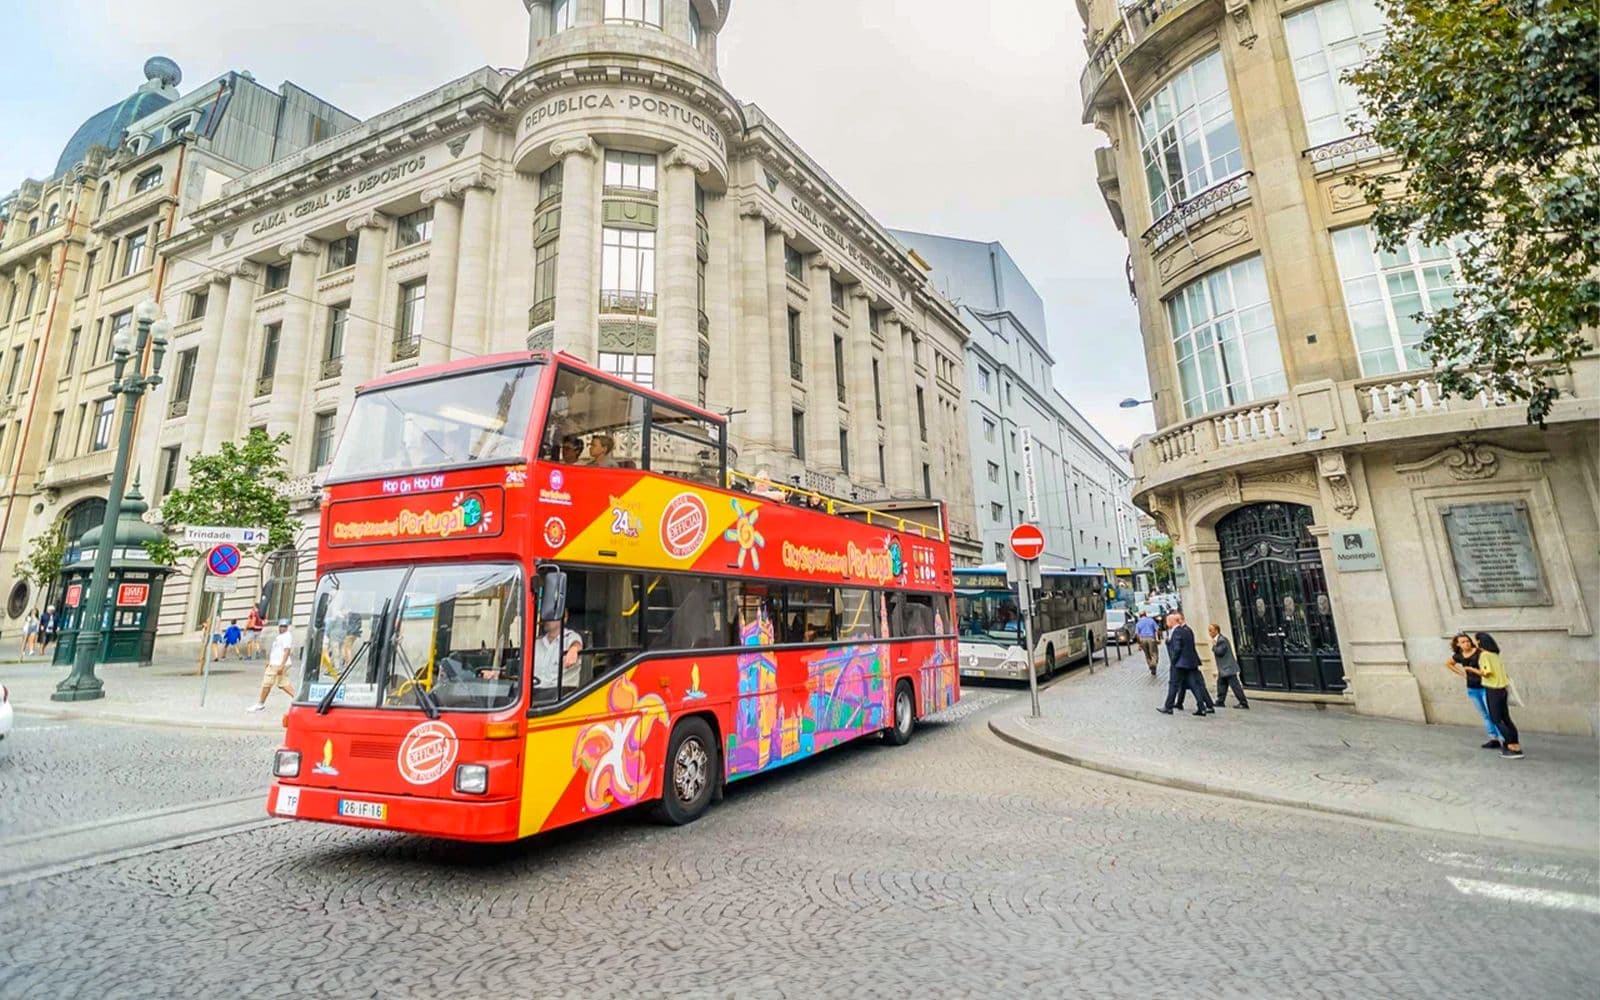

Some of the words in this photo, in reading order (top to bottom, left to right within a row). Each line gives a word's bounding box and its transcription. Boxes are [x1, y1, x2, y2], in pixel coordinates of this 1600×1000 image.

[525, 94, 615, 129] REPUBLICA
[252, 213, 287, 235] CAIXA
[294, 193, 330, 218] GERAL
[336, 186, 352, 202] DE
[357, 155, 426, 194] DEPOSITOS
[382, 480, 398, 492] Hop
[400, 480, 411, 492] On
[413, 477, 429, 489] Hop
[431, 475, 445, 487] Off
[188, 530, 231, 539] Trindade
[399, 506, 464, 537] Portugal
[847, 540, 893, 585] Portugal
[288, 795, 297, 807] TP
